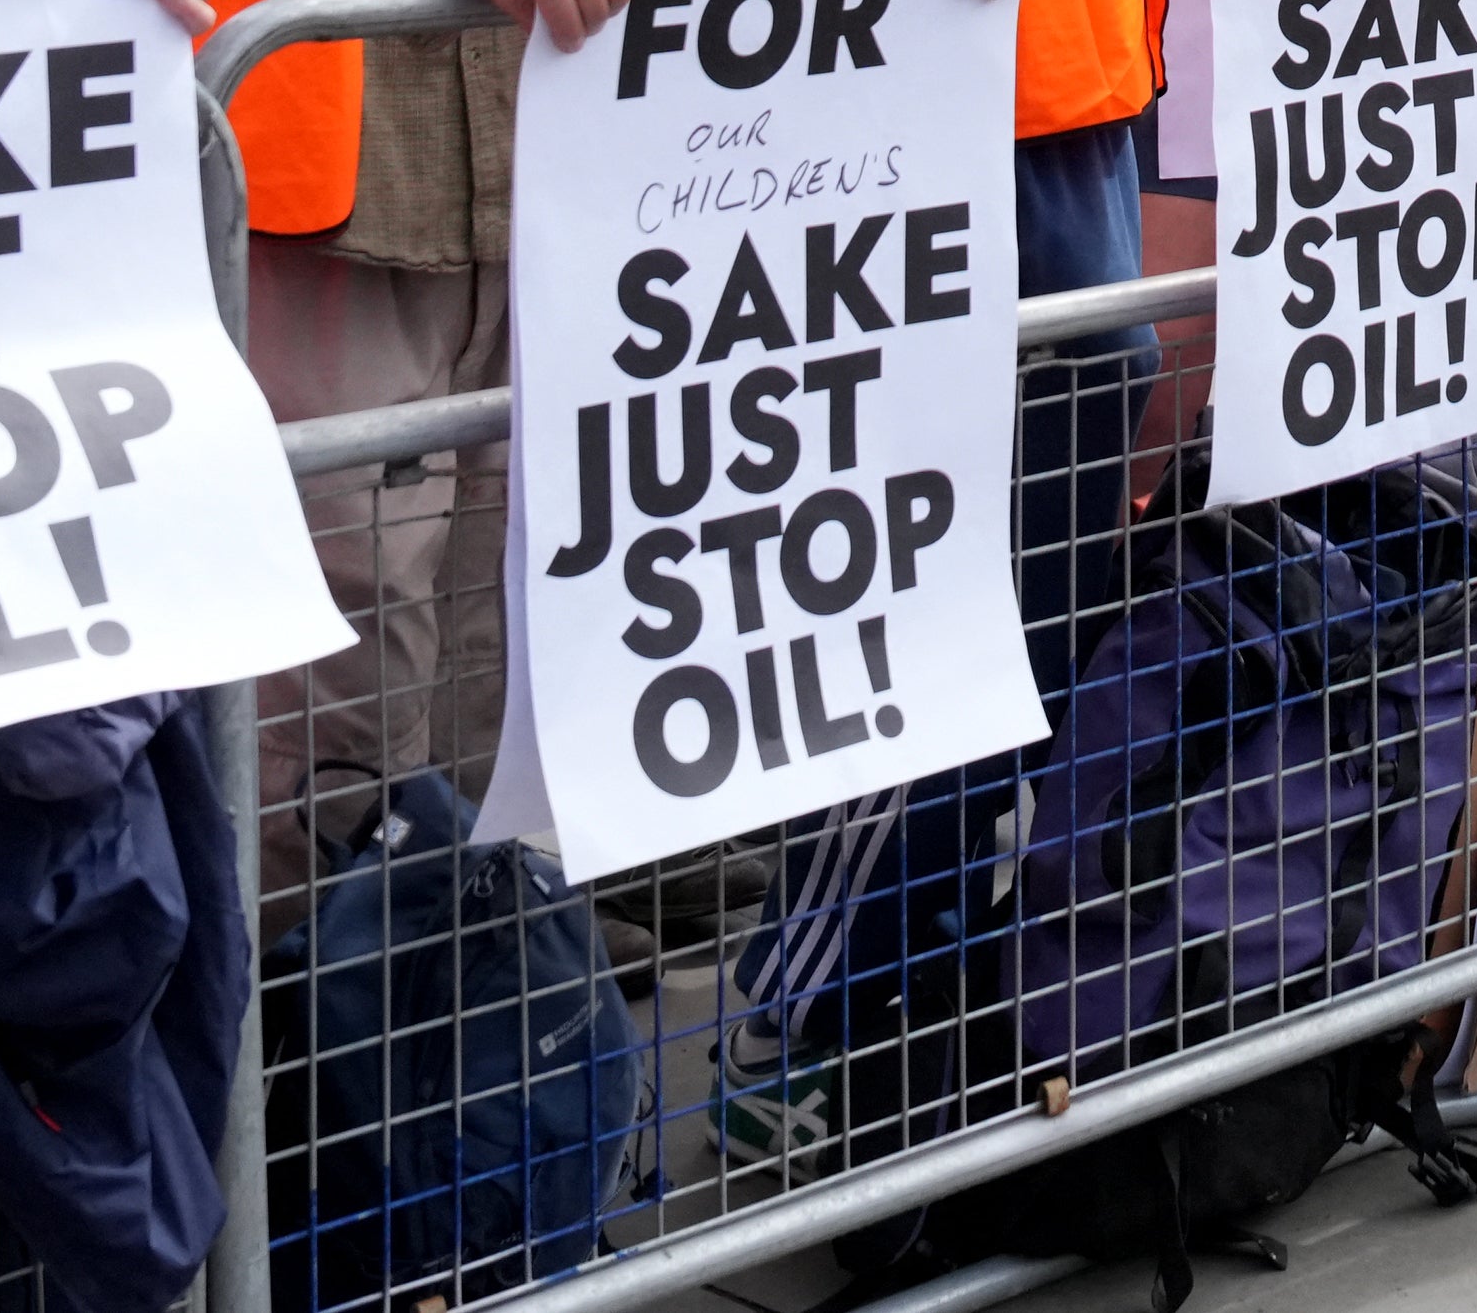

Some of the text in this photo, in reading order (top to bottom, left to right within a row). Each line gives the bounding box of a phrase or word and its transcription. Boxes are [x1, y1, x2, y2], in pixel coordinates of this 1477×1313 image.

[636, 145, 903, 233] CHILDREN'S
[1231, 68, 1475, 259] JUST
[613, 201, 971, 379] SAKE
[1281, 297, 1468, 448] OIL!
[546, 347, 882, 579] JUST
[620, 468, 955, 660] STOP
[632, 616, 905, 798] OIL!
